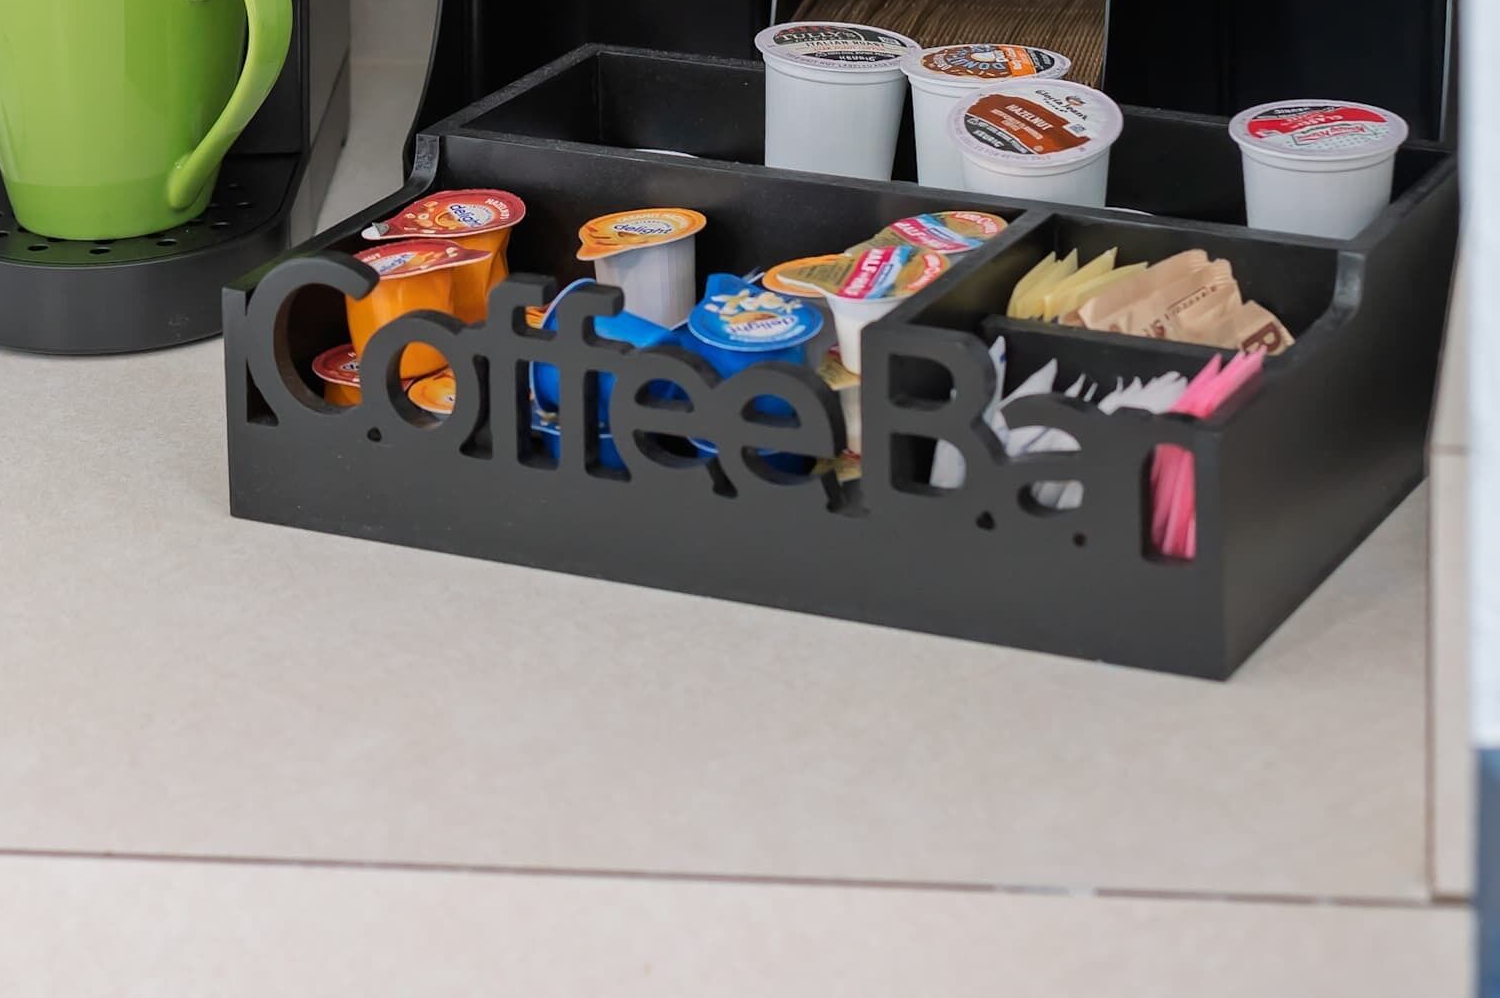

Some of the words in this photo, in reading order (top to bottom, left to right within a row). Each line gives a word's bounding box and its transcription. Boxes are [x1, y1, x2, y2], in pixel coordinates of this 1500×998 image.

[613, 223, 672, 235] delight
[245, 256, 842, 502] Coffee
[860, 324, 1222, 565] Bar
